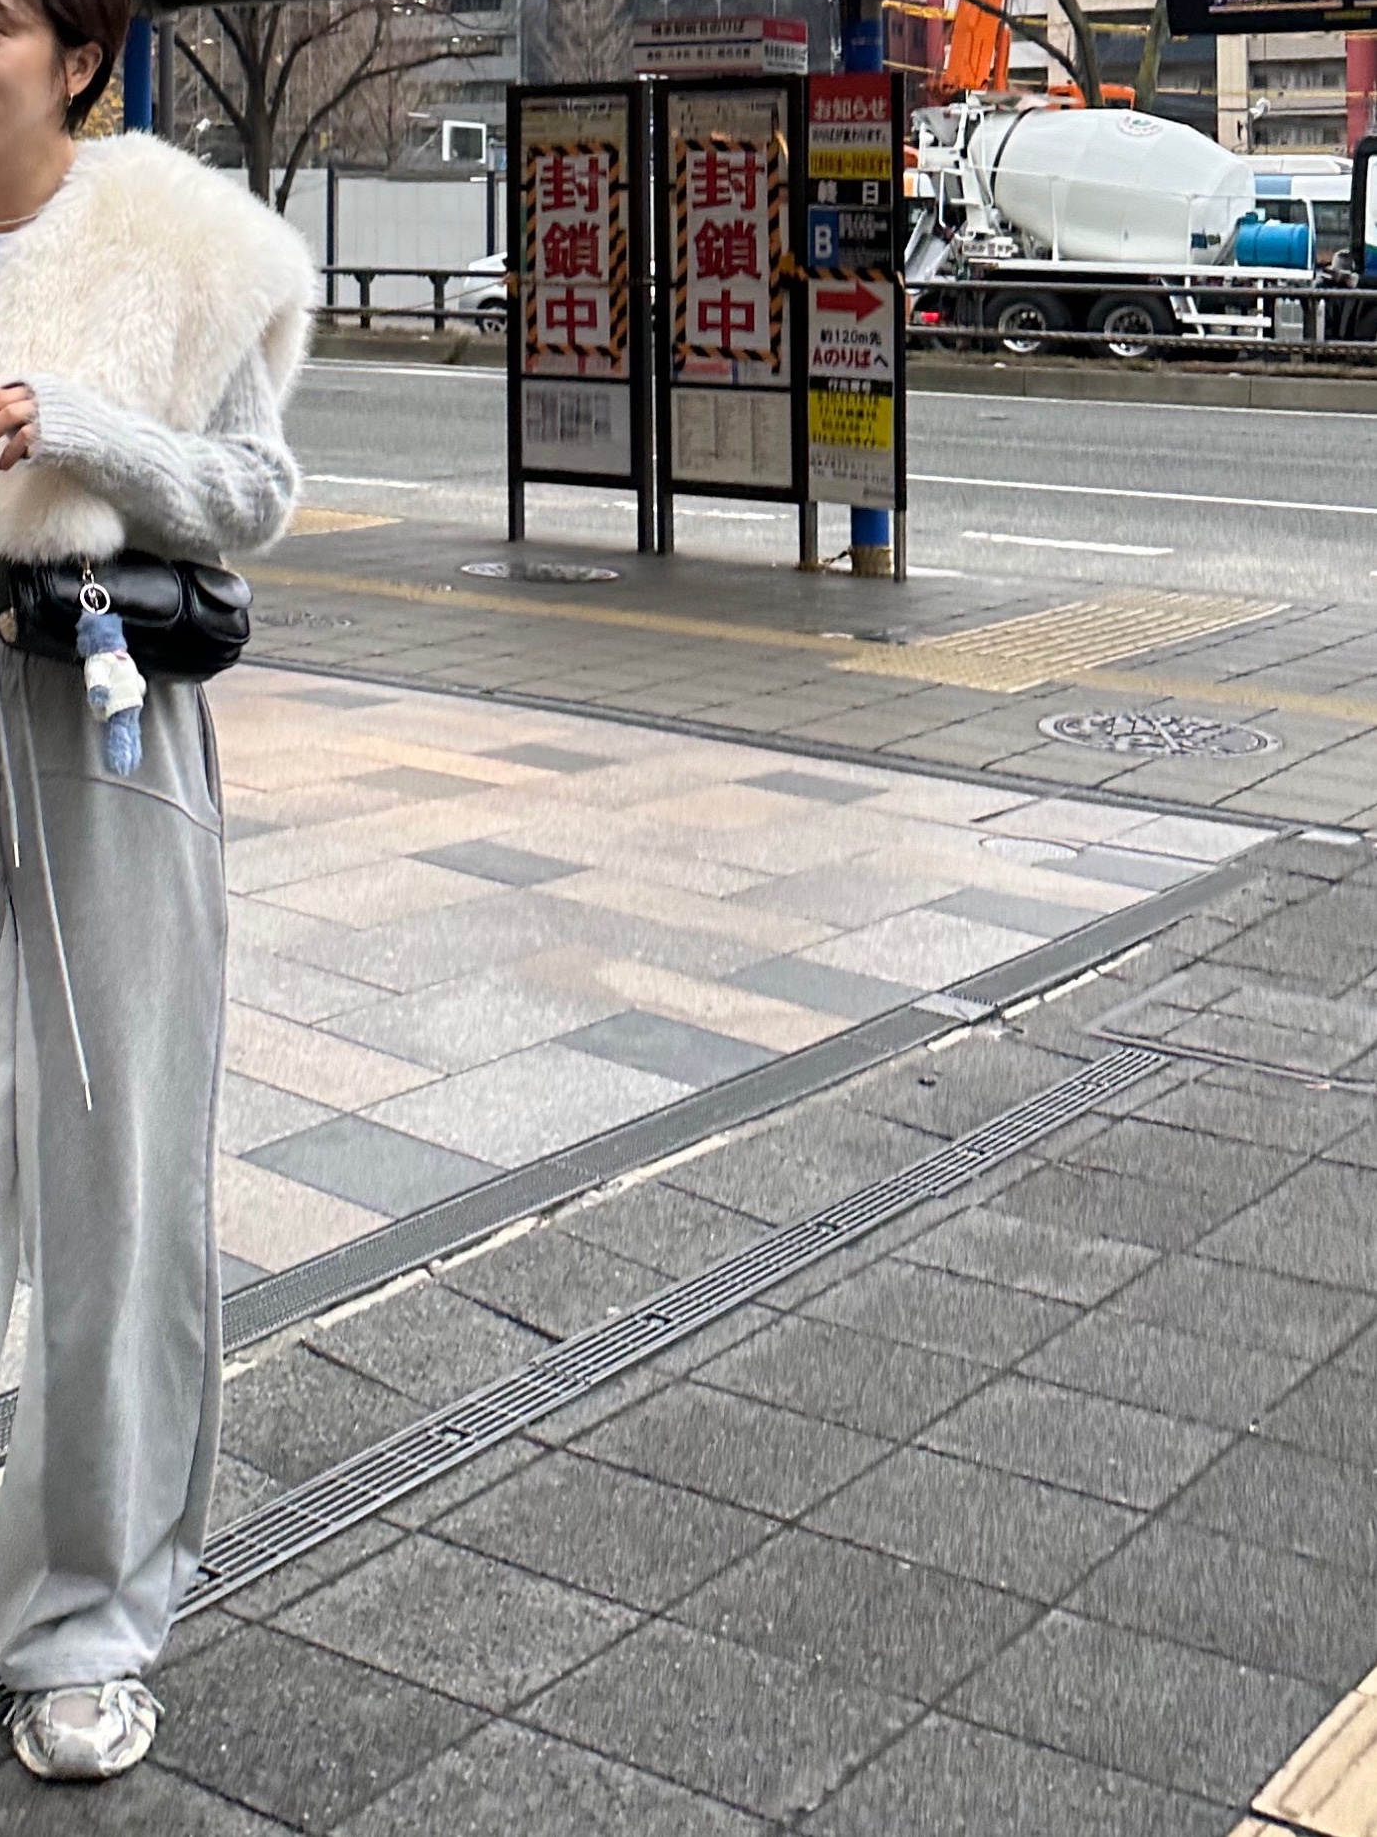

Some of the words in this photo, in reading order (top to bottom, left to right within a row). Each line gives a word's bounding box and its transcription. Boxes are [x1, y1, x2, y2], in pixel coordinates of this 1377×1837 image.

[814, 95, 888, 121] お知らせ
[539, 152, 608, 346] 封鎖中
[691, 150, 766, 347] 封鎖中
[815, 224, 832, 260] B
